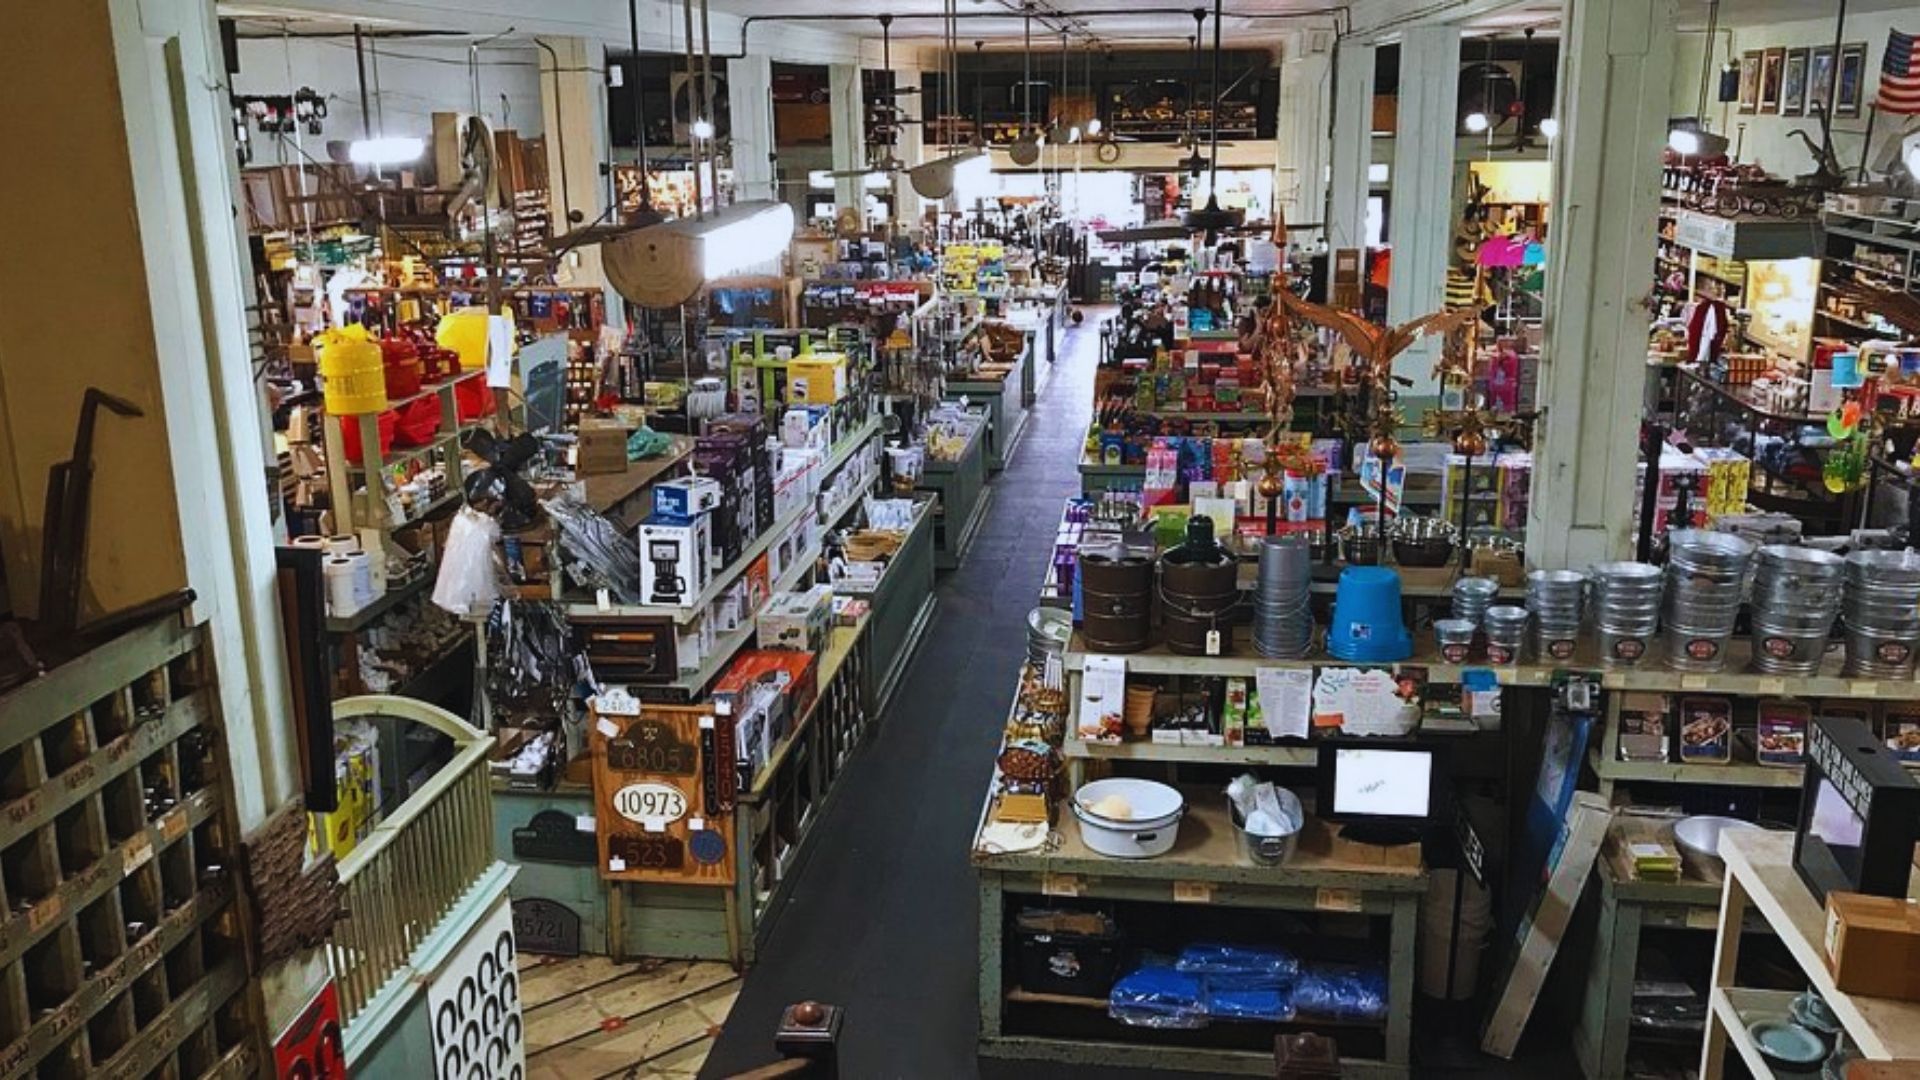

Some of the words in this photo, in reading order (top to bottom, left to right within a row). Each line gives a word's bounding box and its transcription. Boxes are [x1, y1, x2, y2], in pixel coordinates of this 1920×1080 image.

[622, 746, 680, 770] 6805
[622, 790, 682, 816] 10973
[626, 842, 667, 865] 523
